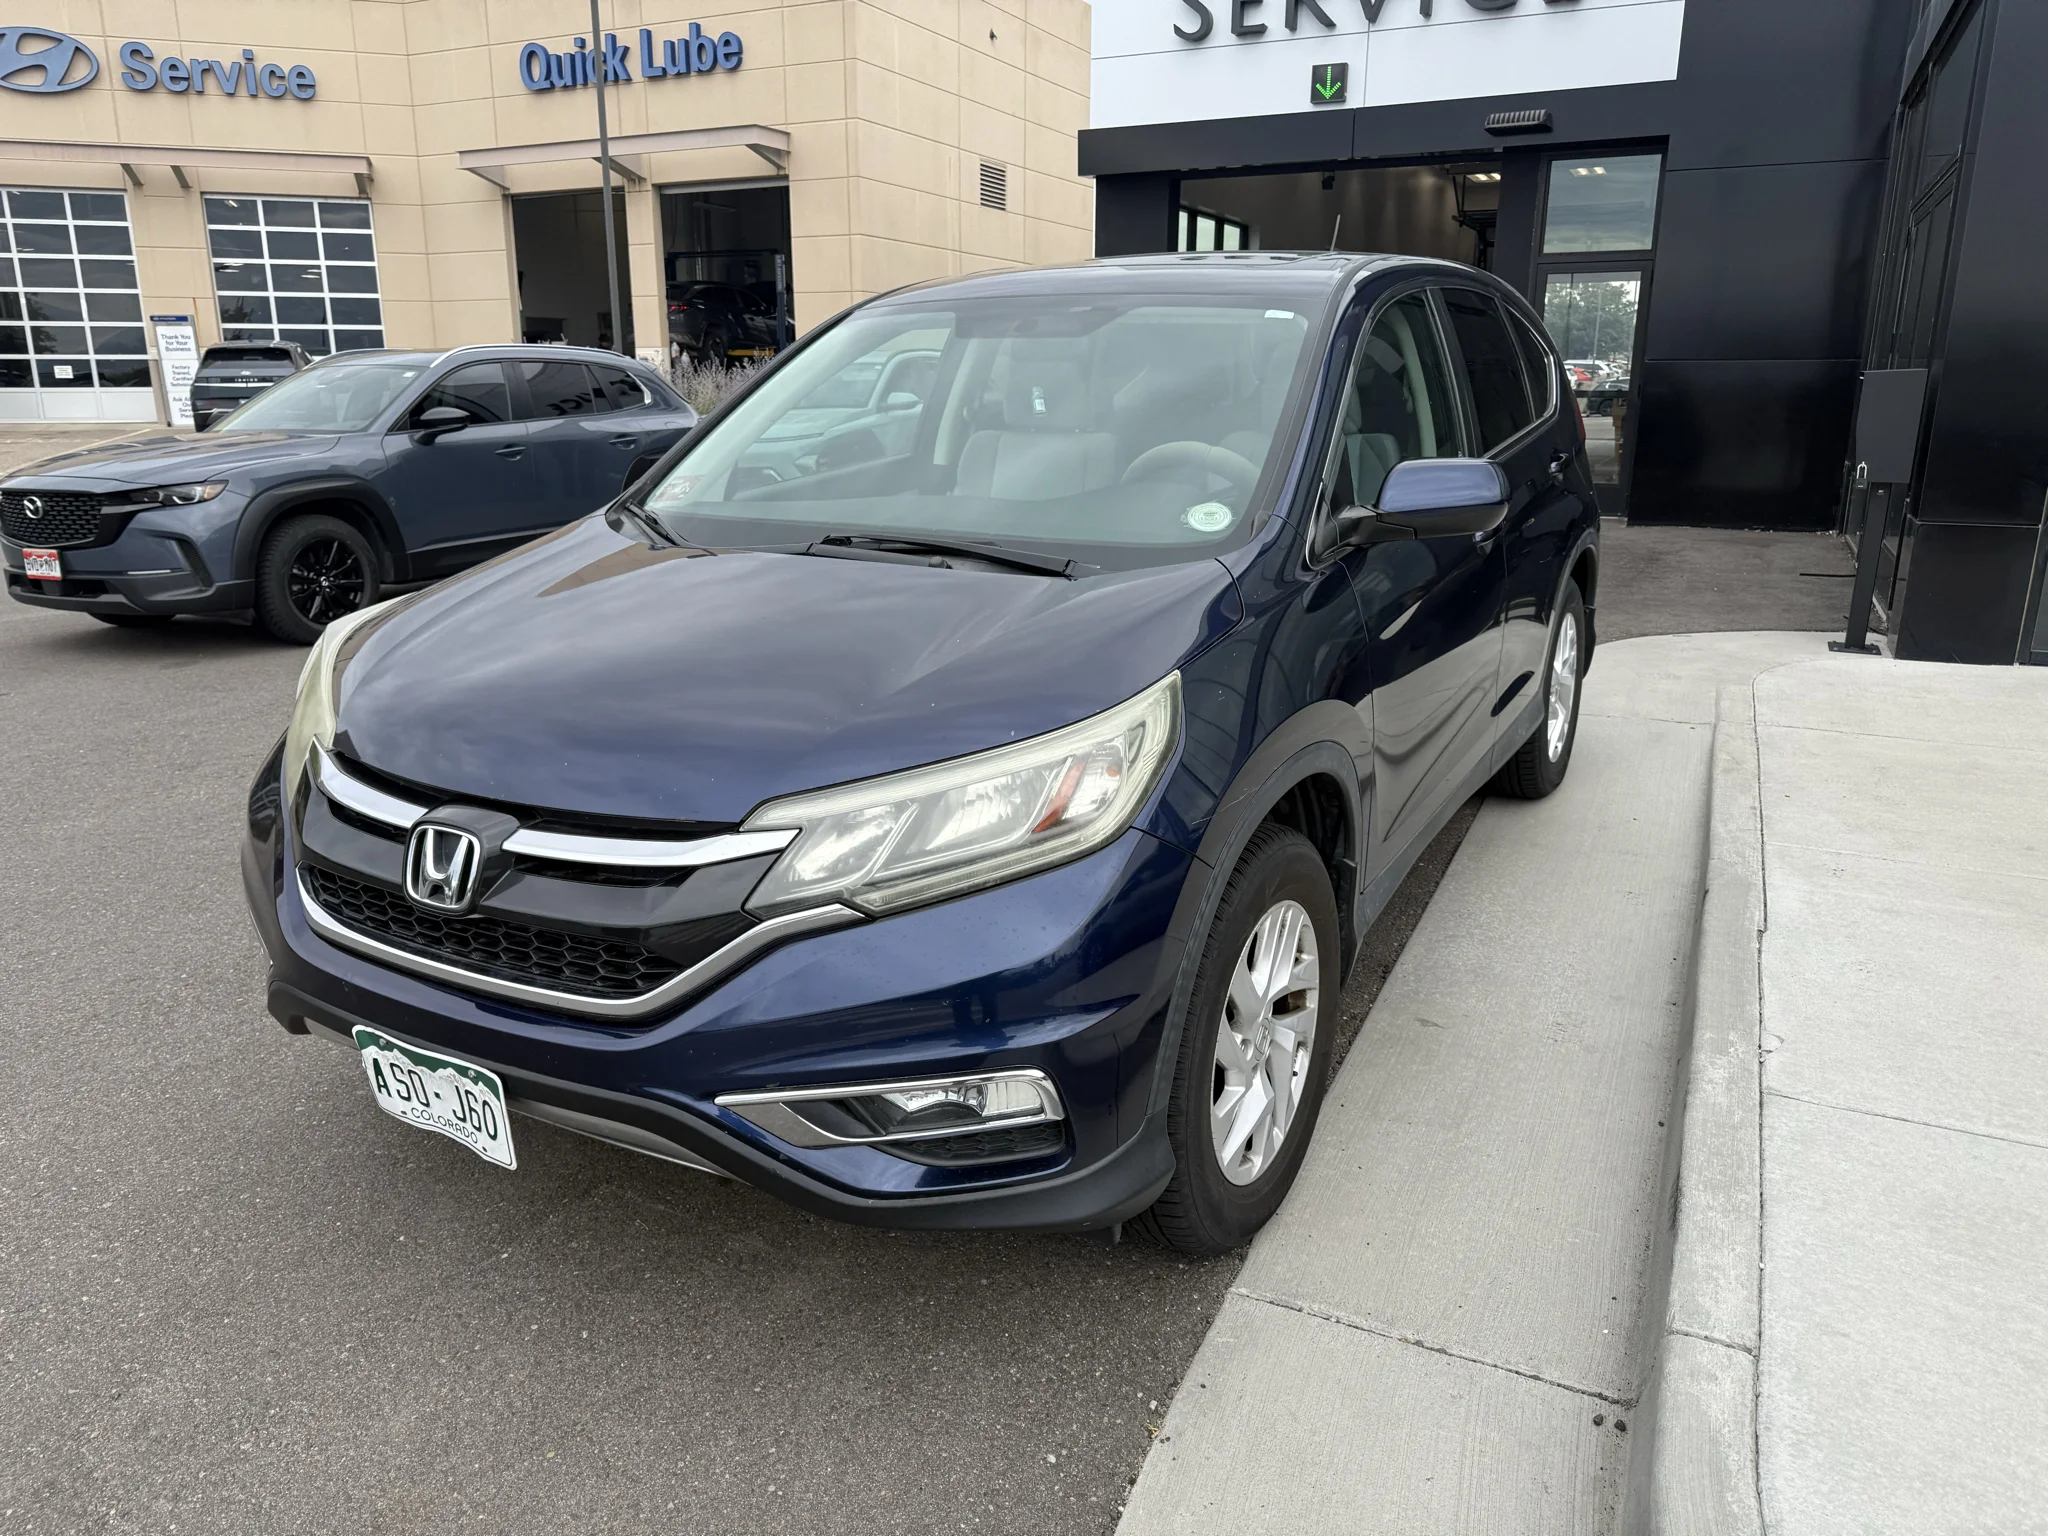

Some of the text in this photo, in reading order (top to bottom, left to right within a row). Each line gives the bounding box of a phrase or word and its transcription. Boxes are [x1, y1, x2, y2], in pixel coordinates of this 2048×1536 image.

[120, 41, 316, 99] Service
[520, 22, 744, 91] Quick Lube
[411, 1107, 479, 1144] COLORADO
